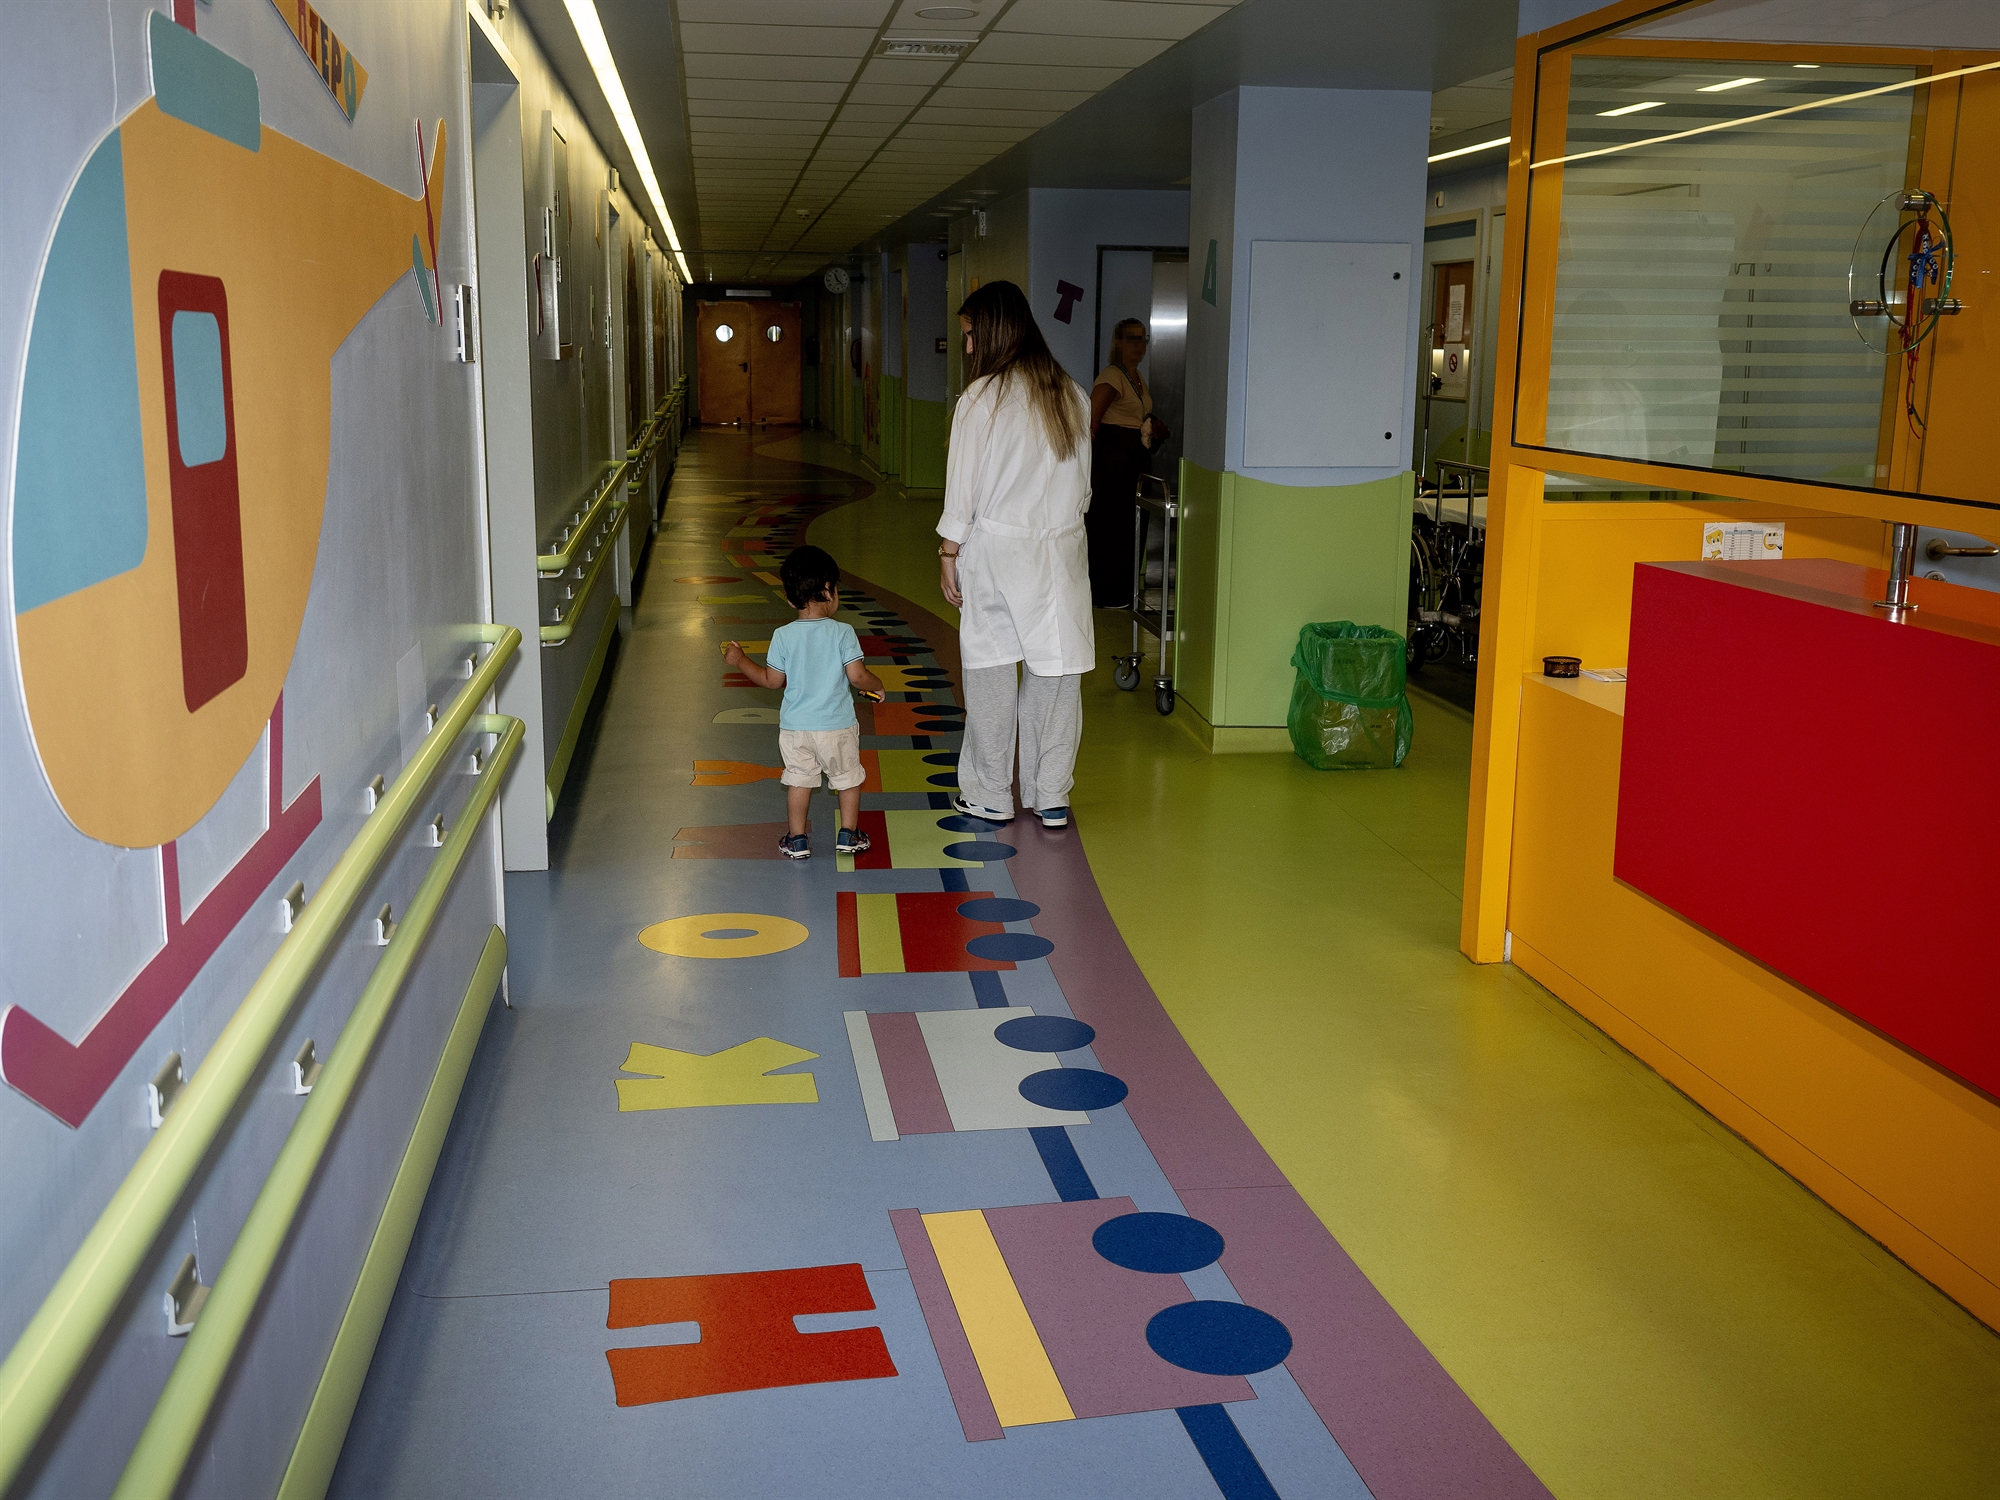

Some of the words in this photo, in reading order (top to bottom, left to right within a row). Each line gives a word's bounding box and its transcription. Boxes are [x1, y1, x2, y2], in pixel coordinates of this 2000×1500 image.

[637, 912, 809, 959] Ο
[615, 1037, 820, 1112] Κ
[606, 1263, 898, 1407] Η
